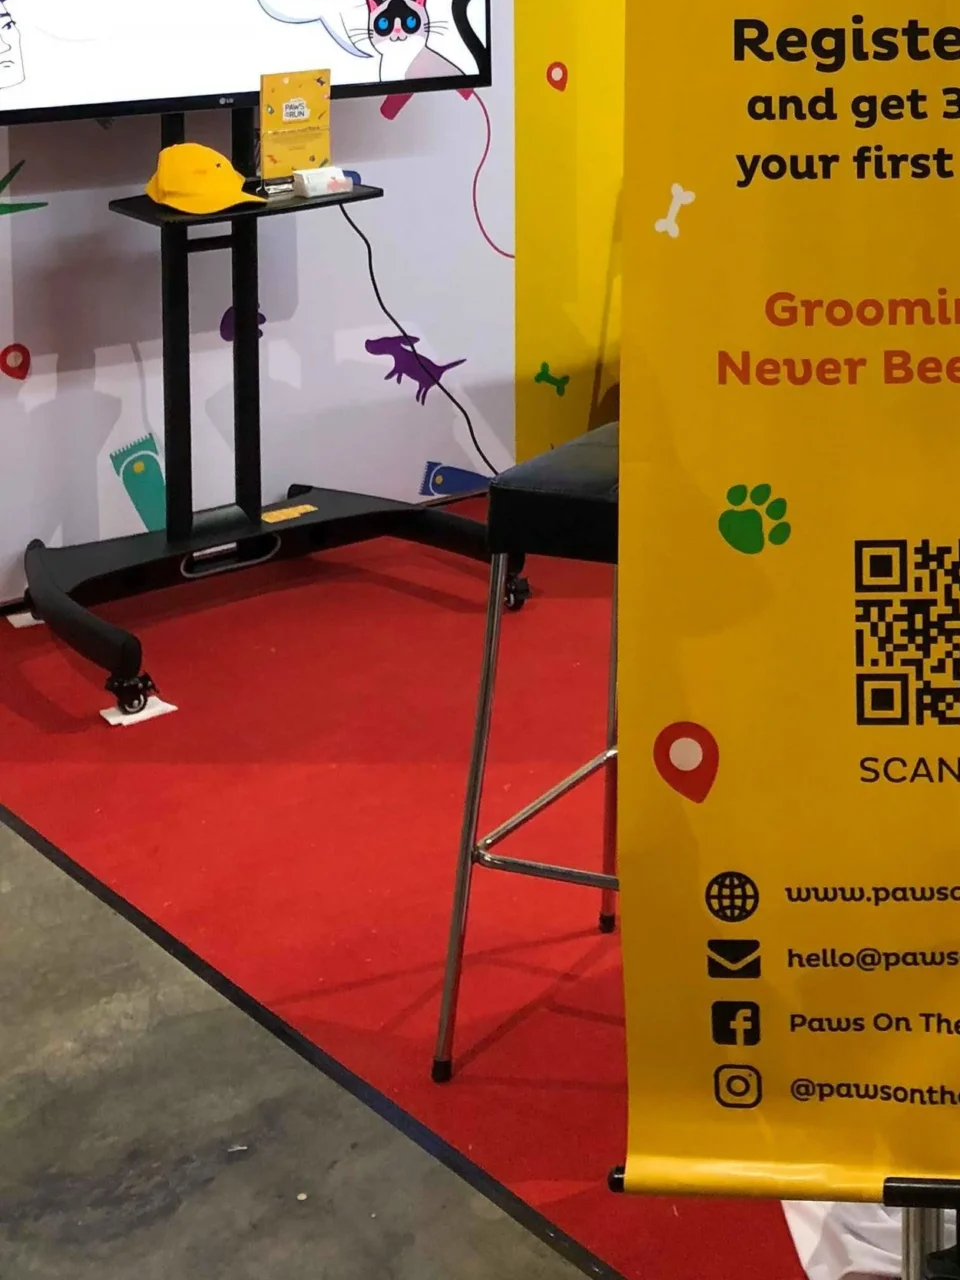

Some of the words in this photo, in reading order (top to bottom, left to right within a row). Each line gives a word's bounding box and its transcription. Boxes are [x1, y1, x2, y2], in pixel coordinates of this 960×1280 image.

[747, 87, 838, 121] and
[851, 88, 929, 129] get
[735, 154, 840, 188] your
[852, 144, 955, 180] first
[718, 351, 866, 386] Never
[789, 1013, 866, 1033] Paws
[872, 1012, 913, 1032] On
